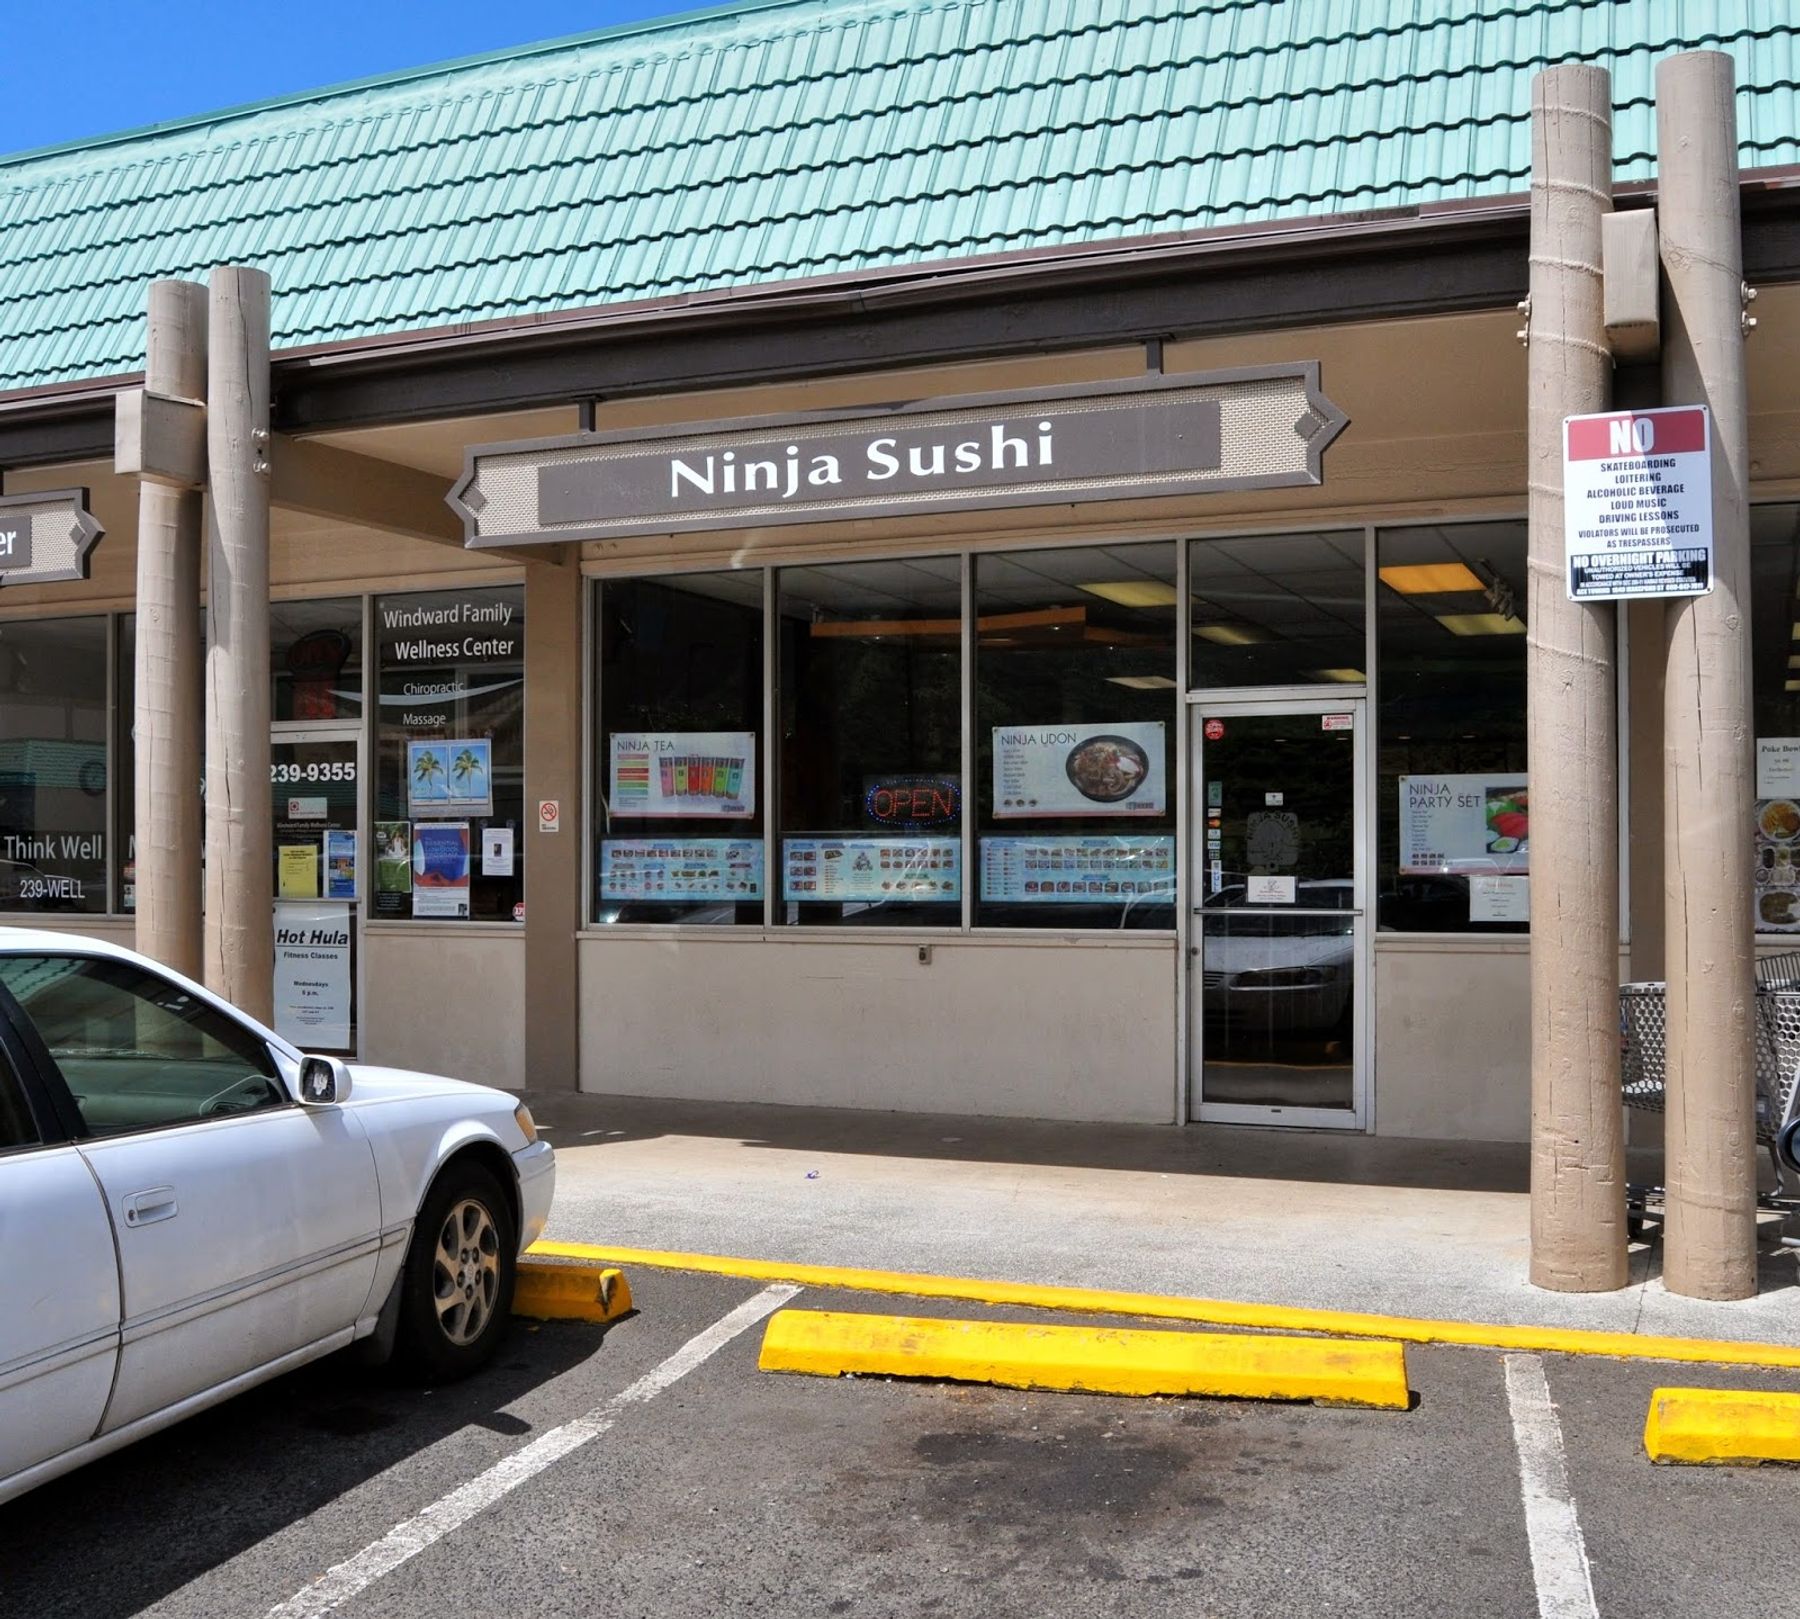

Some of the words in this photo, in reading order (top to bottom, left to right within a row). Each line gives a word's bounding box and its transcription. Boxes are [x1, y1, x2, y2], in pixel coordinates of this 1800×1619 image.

[1608, 417, 1654, 455] NO
[671, 444, 842, 498] Ninja
[866, 421, 1053, 480] Sushi
[1600, 458, 1676, 472] SKATEBOARDING
[1615, 472, 1662, 484] LOITERING
[1587, 487, 1637, 499] ALCOHOLIC
[1639, 483, 1685, 496] BEVERAGE
[1610, 500, 1634, 510] LOUD
[1636, 498, 1667, 508] MUSIC
[1599, 512, 1637, 524] DRIVING
[1639, 510, 1680, 521] LESSONS
[1578, 528, 1619, 539] VIOLATORS
[1620, 527, 1638, 537] WILL
[1640, 526, 1649, 536] BE
[1650, 523, 1700, 535] PROSECUTED
[1606, 540, 1617, 549] AS
[1618, 537, 1671, 548] TRESPASSERS
[1572, 555, 1589, 568] NO
[1590, 552, 1654, 567] OVERNIGHT
[1655, 549, 1707, 564] PARKING
[384, 604, 459, 629] Windward
[463, 602, 513, 626] Family
[395, 640, 460, 660] Wellness
[463, 637, 515, 656] Center
[403, 682, 464, 696] Chiropractic
[402, 713, 447, 727] Massage
[617, 740, 650, 751] NINJA
[654, 740, 675, 751] TEA
[1001, 734, 1037, 746] NINJA
[1040, 732, 1077, 745] UDON
[1409, 784, 1451, 795] NINJA
[874, 787, 952, 817] OPEN
[1409, 796, 1453, 809] PARTY
[1457, 795, 1481, 808] SET
[4, 835, 57, 859] Think
[61, 834, 103, 859] Well
[20, 879, 86, 899] 239-WELL
[276, 929, 306, 944] Hot
[309, 930, 348, 945] Hula
[284, 951, 309, 959] Fitness
[310, 952, 338, 960] Classes
[293, 980, 329, 988] Wednesdays
